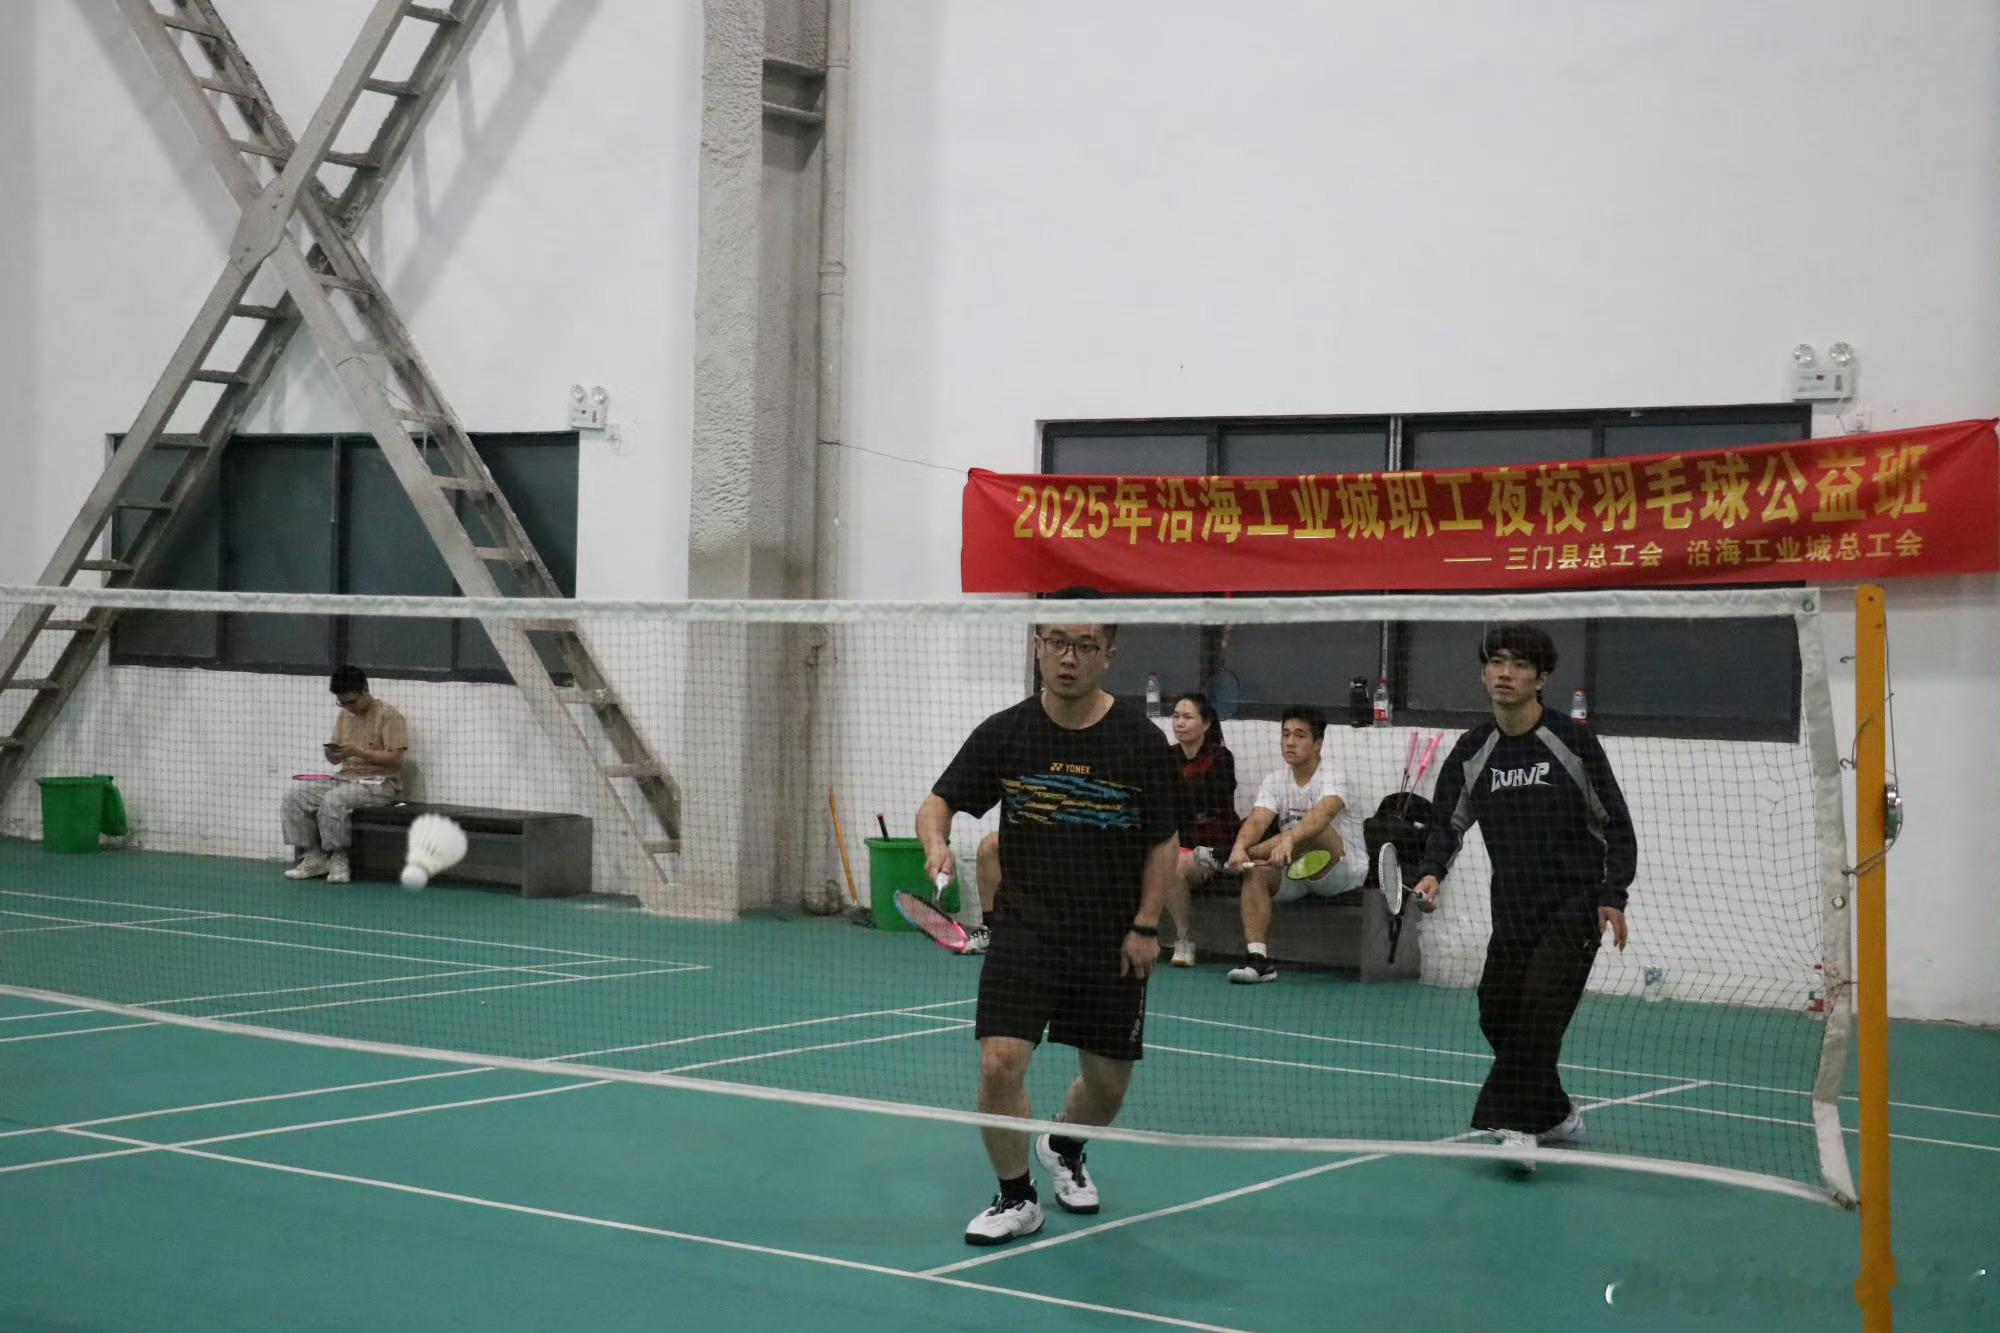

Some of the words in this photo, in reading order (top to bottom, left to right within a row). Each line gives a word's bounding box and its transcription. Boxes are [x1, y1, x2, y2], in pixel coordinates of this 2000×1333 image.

[1013, 443, 1929, 545] 2025年沿海工业城职工夜校羽毛球公益班
[1686, 528, 1926, 565] 沿海工业城总工会
